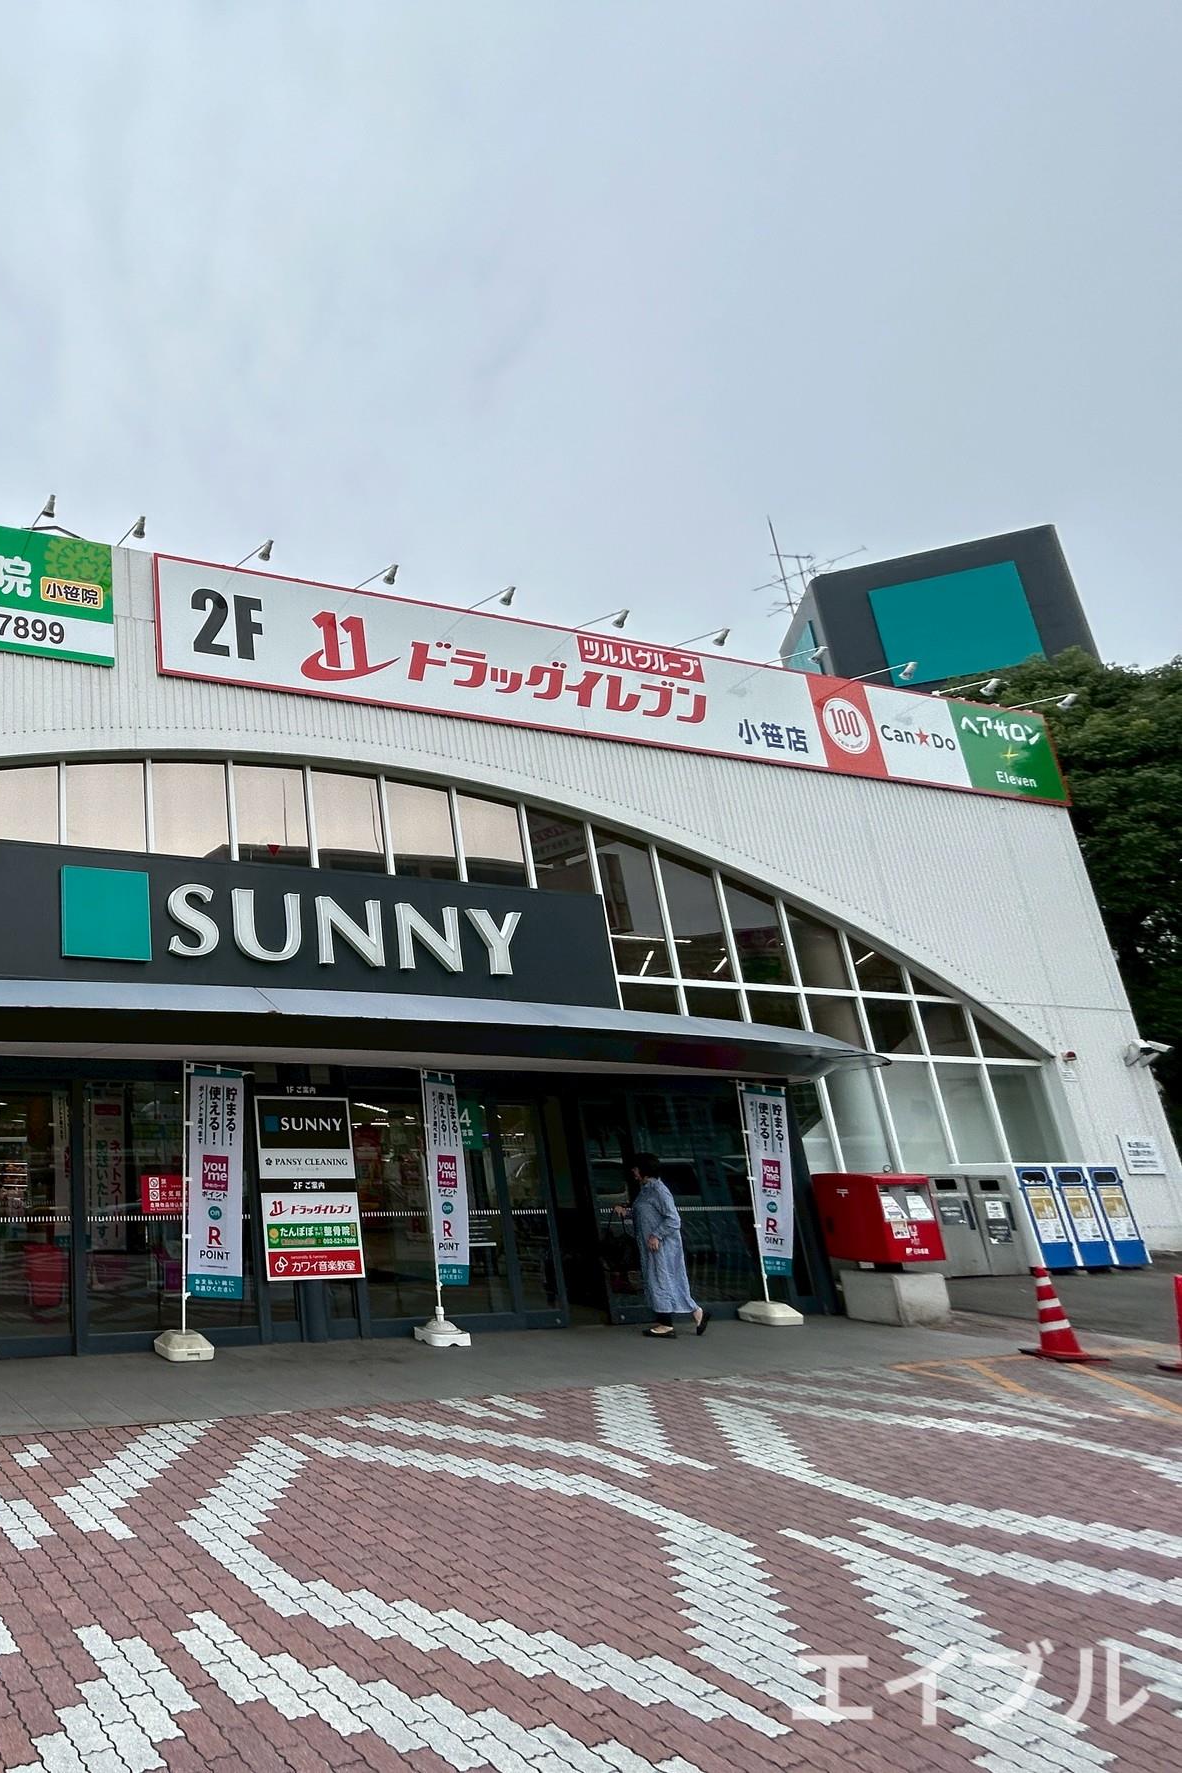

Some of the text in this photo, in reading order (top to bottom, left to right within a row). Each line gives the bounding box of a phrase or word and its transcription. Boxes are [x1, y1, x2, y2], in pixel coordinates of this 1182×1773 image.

[46, 581, 99, 606] 小笹院
[190, 588, 264, 661] 2F
[583, 639, 699, 676] ツルハグループ
[407, 641, 707, 724] ドラッグイレブン
[828, 708, 862, 738] 100
[960, 715, 1042, 745] ヘアサロン
[737, 718, 810, 754] 小笹店
[996, 770, 1037, 788] Eleven
[166, 882, 522, 976] SUNNY
[209, 1086, 221, 1145] 使える！
[226, 1087, 238, 1147] 貯まる！
[280, 1116, 342, 1131] SUNNY
[460, 1107, 472, 1127] 4
[203, 1161, 227, 1174] you
[275, 1158, 348, 1166] PANSY CLEANING
[438, 1161, 455, 1172] you
[207, 1171, 228, 1181] me
[441, 1170, 457, 1179] me
[766, 1173, 780, 1181] me
[293, 1181, 303, 1190] 2F
[290, 1203, 352, 1215] ドラッグイレブン
[207, 1226, 223, 1247] R
[442, 1220, 453, 1240] R
[764, 1236, 785, 1246] OINT
[199, 1250, 230, 1261] POINT
[291, 1260, 357, 1273] カワイ音楽教室
